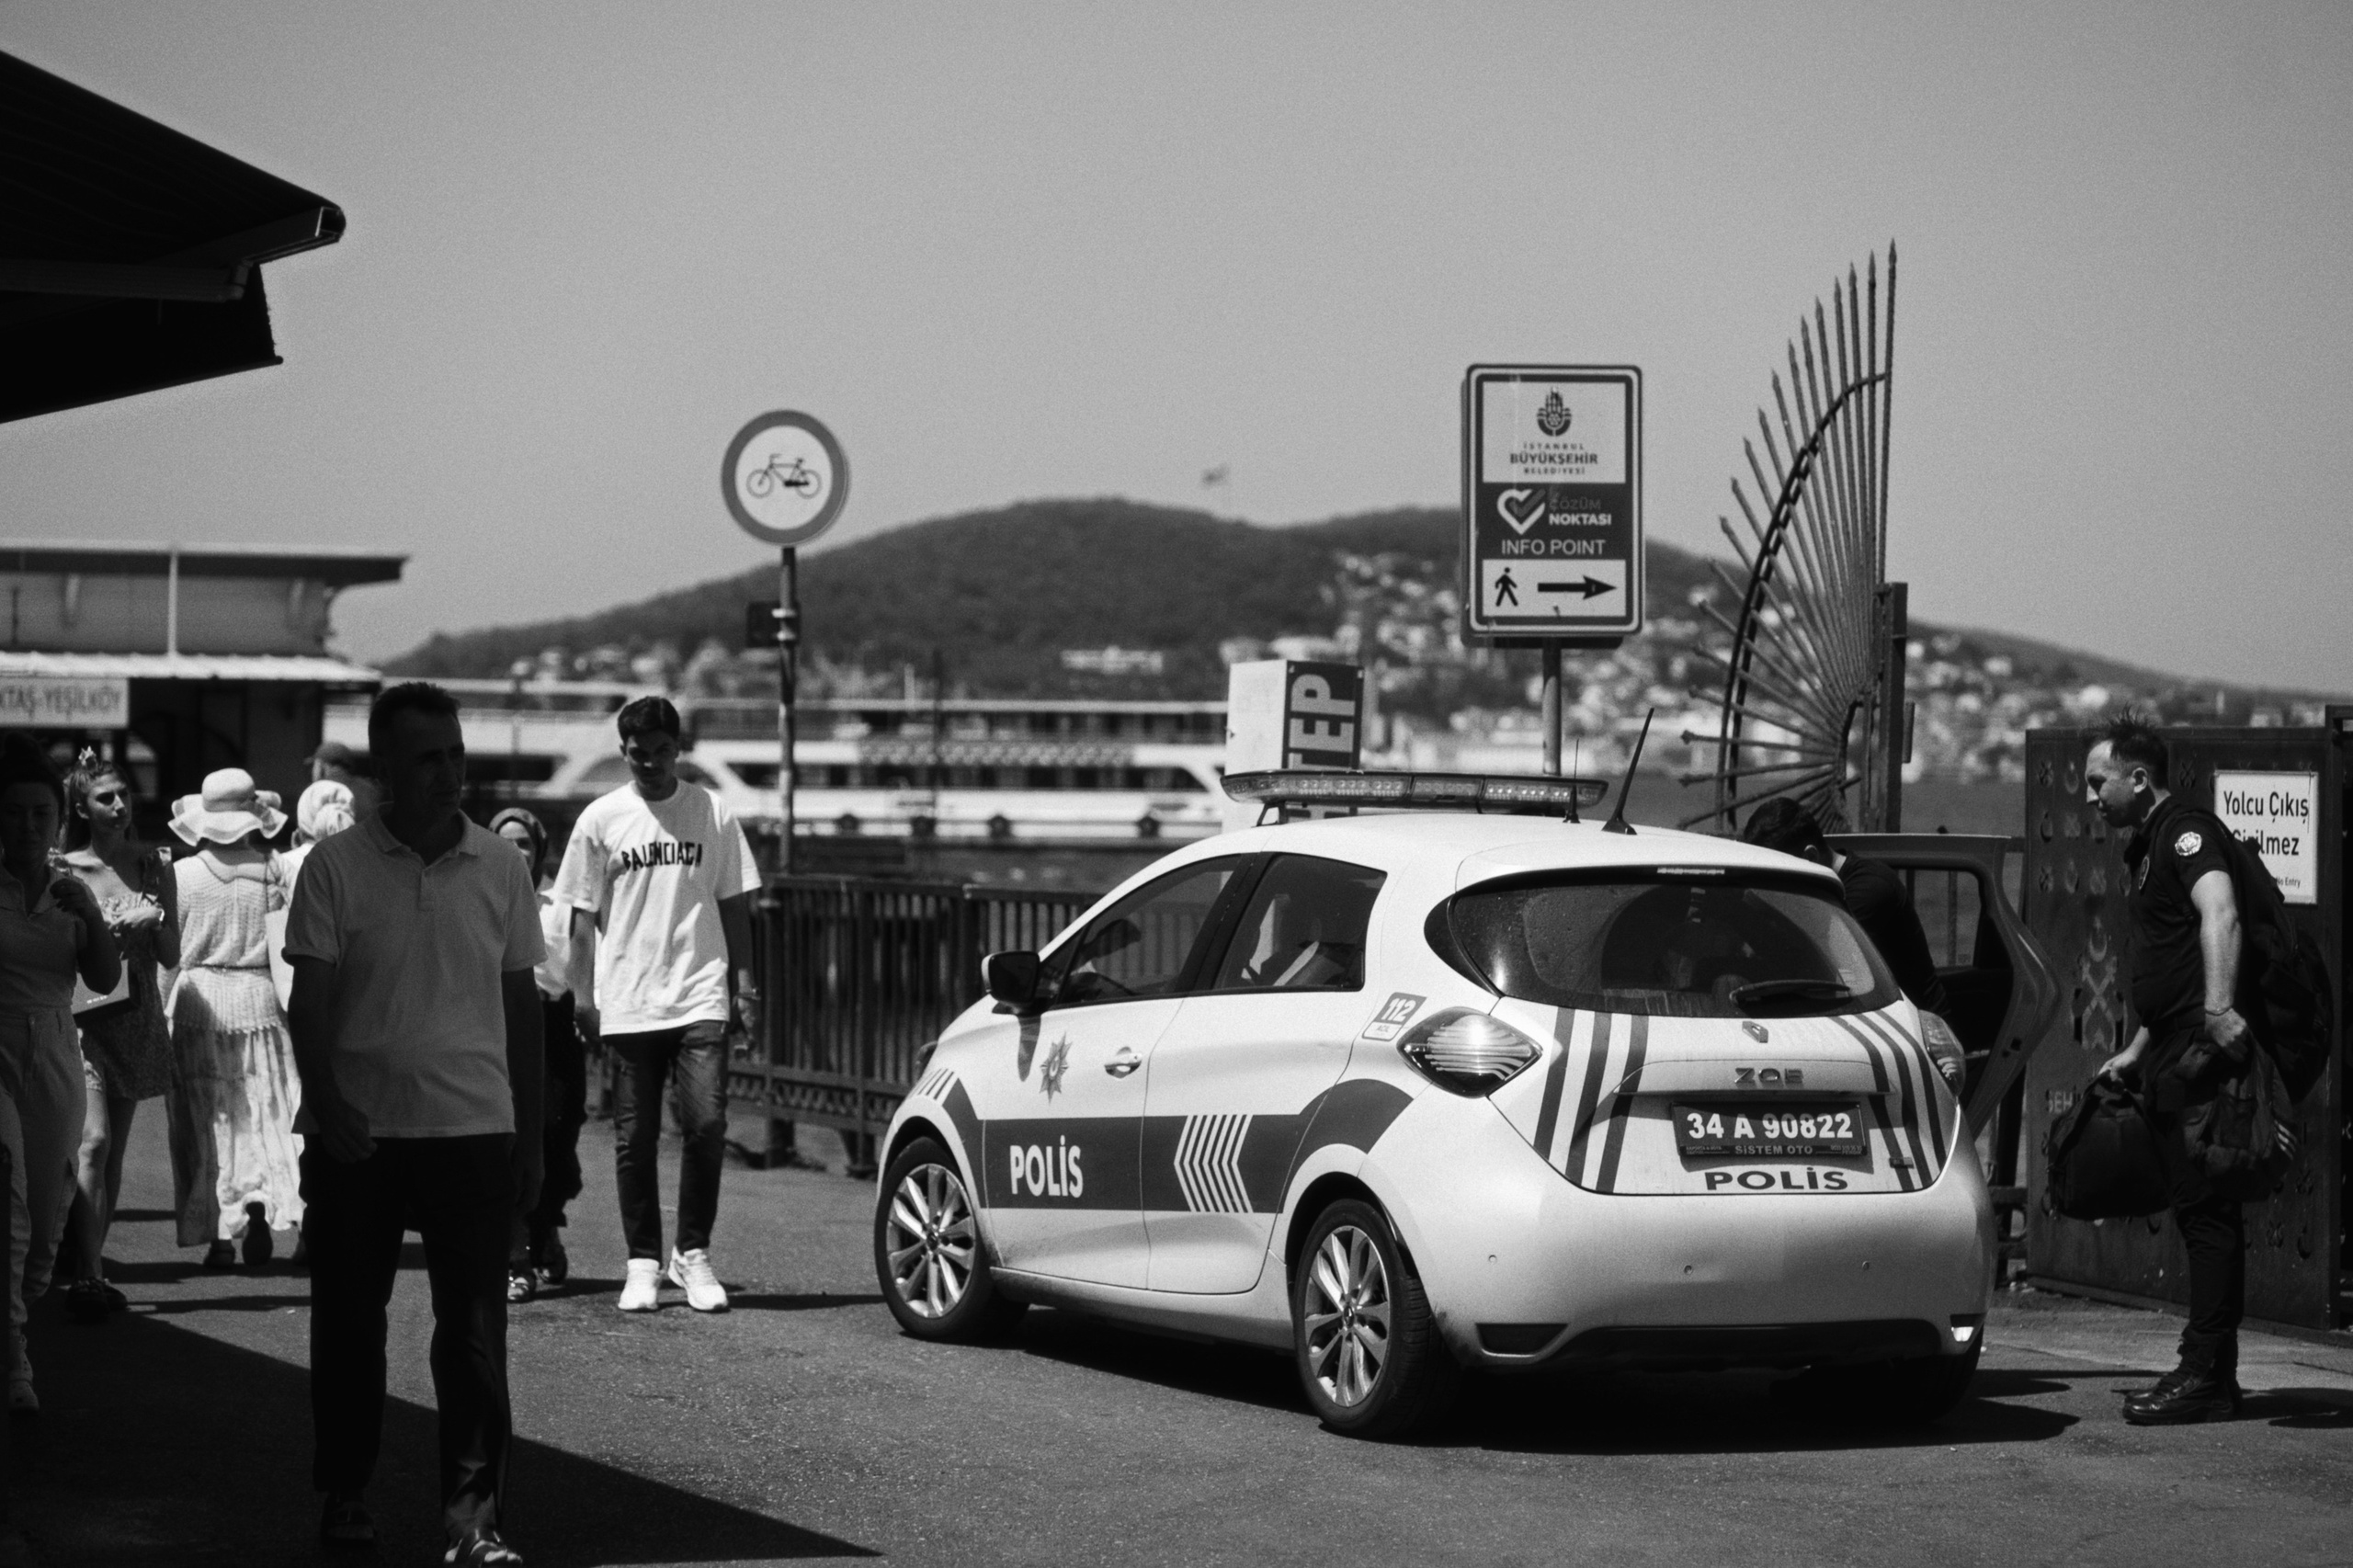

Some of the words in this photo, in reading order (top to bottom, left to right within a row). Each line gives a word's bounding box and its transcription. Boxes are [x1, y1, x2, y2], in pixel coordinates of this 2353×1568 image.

[1509, 451, 1598, 464] BÜYÜKŞEHİR
[1549, 513, 1612, 526] NOKTASI
[1501, 539, 1545, 555] INFO
[1550, 539, 1606, 555] POINT
[2223, 790, 2264, 816] Yolcu
[2269, 791, 2309, 824] Çıkış
[1381, 998, 1416, 1022] 112
[1734, 1067, 1804, 1084] ZOE
[1687, 1112, 1724, 1139] 34
[1733, 1112, 1756, 1139] A
[1762, 1112, 1853, 1139] 90822
[1787, 1145, 1813, 1154] OTO
[1010, 1135, 1084, 1199] POLİS
[1704, 1166, 1848, 1191] POLİS
